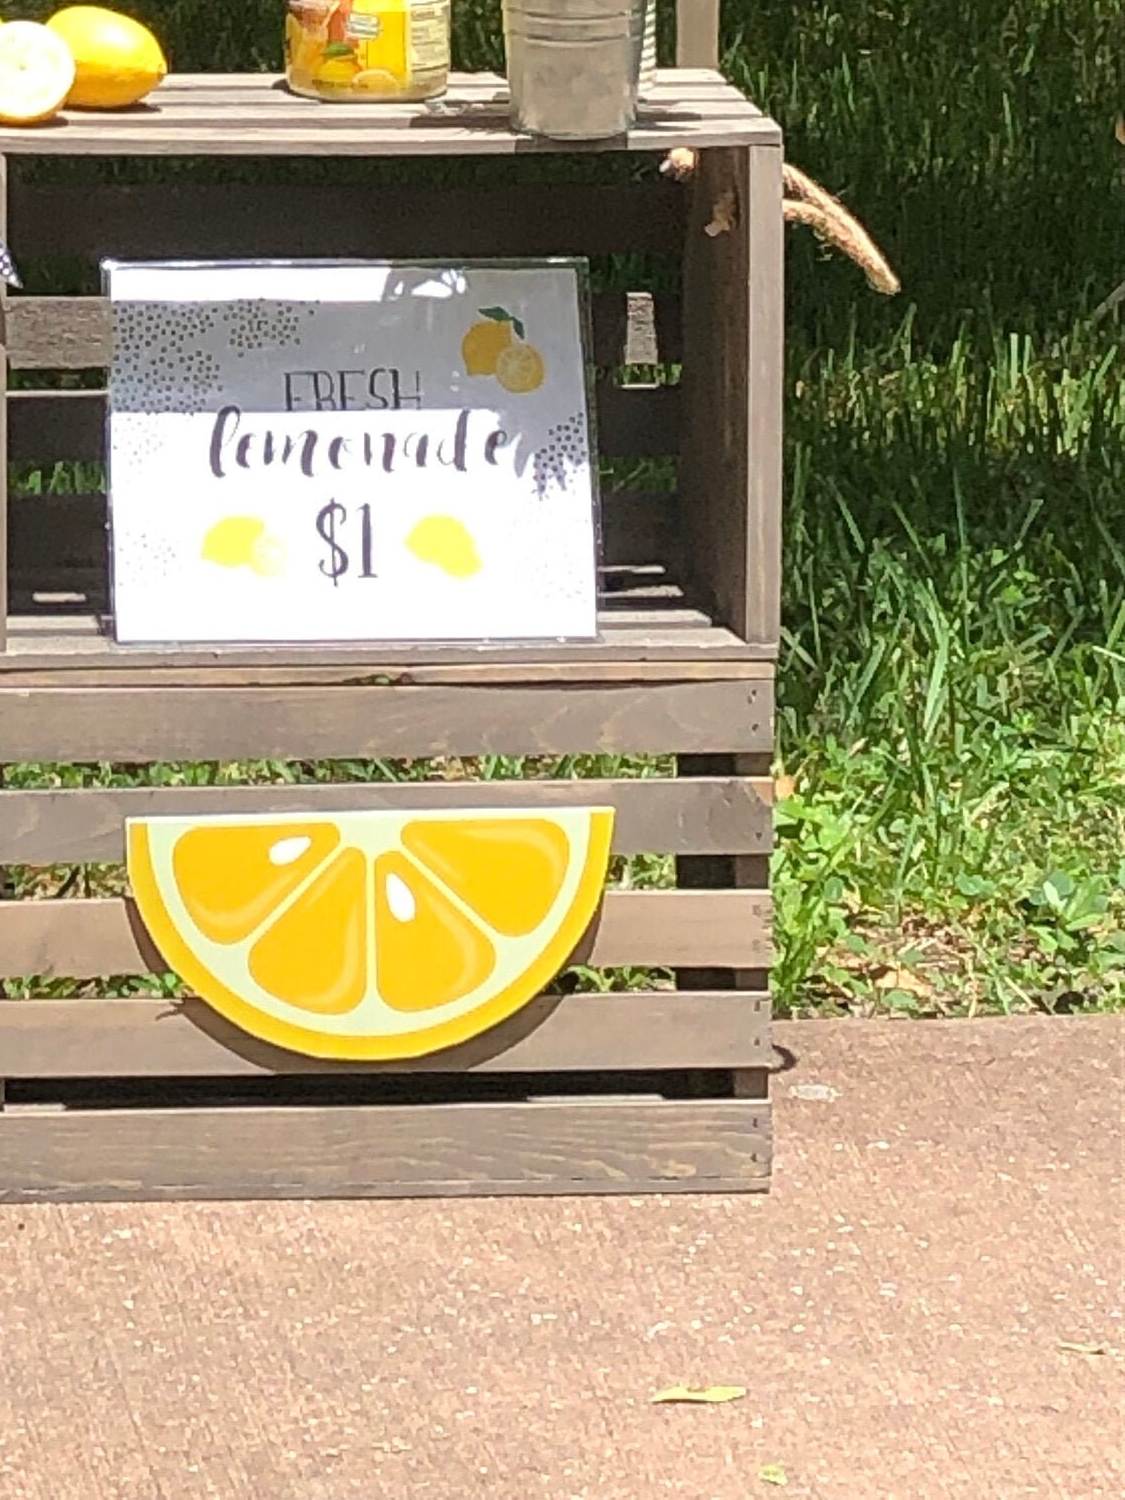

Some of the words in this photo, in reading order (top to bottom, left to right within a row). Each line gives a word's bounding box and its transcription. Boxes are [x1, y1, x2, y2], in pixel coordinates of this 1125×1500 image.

[283, 368, 422, 411] FRESH
[209, 405, 507, 477] lemonade
[316, 498, 378, 587] $1
